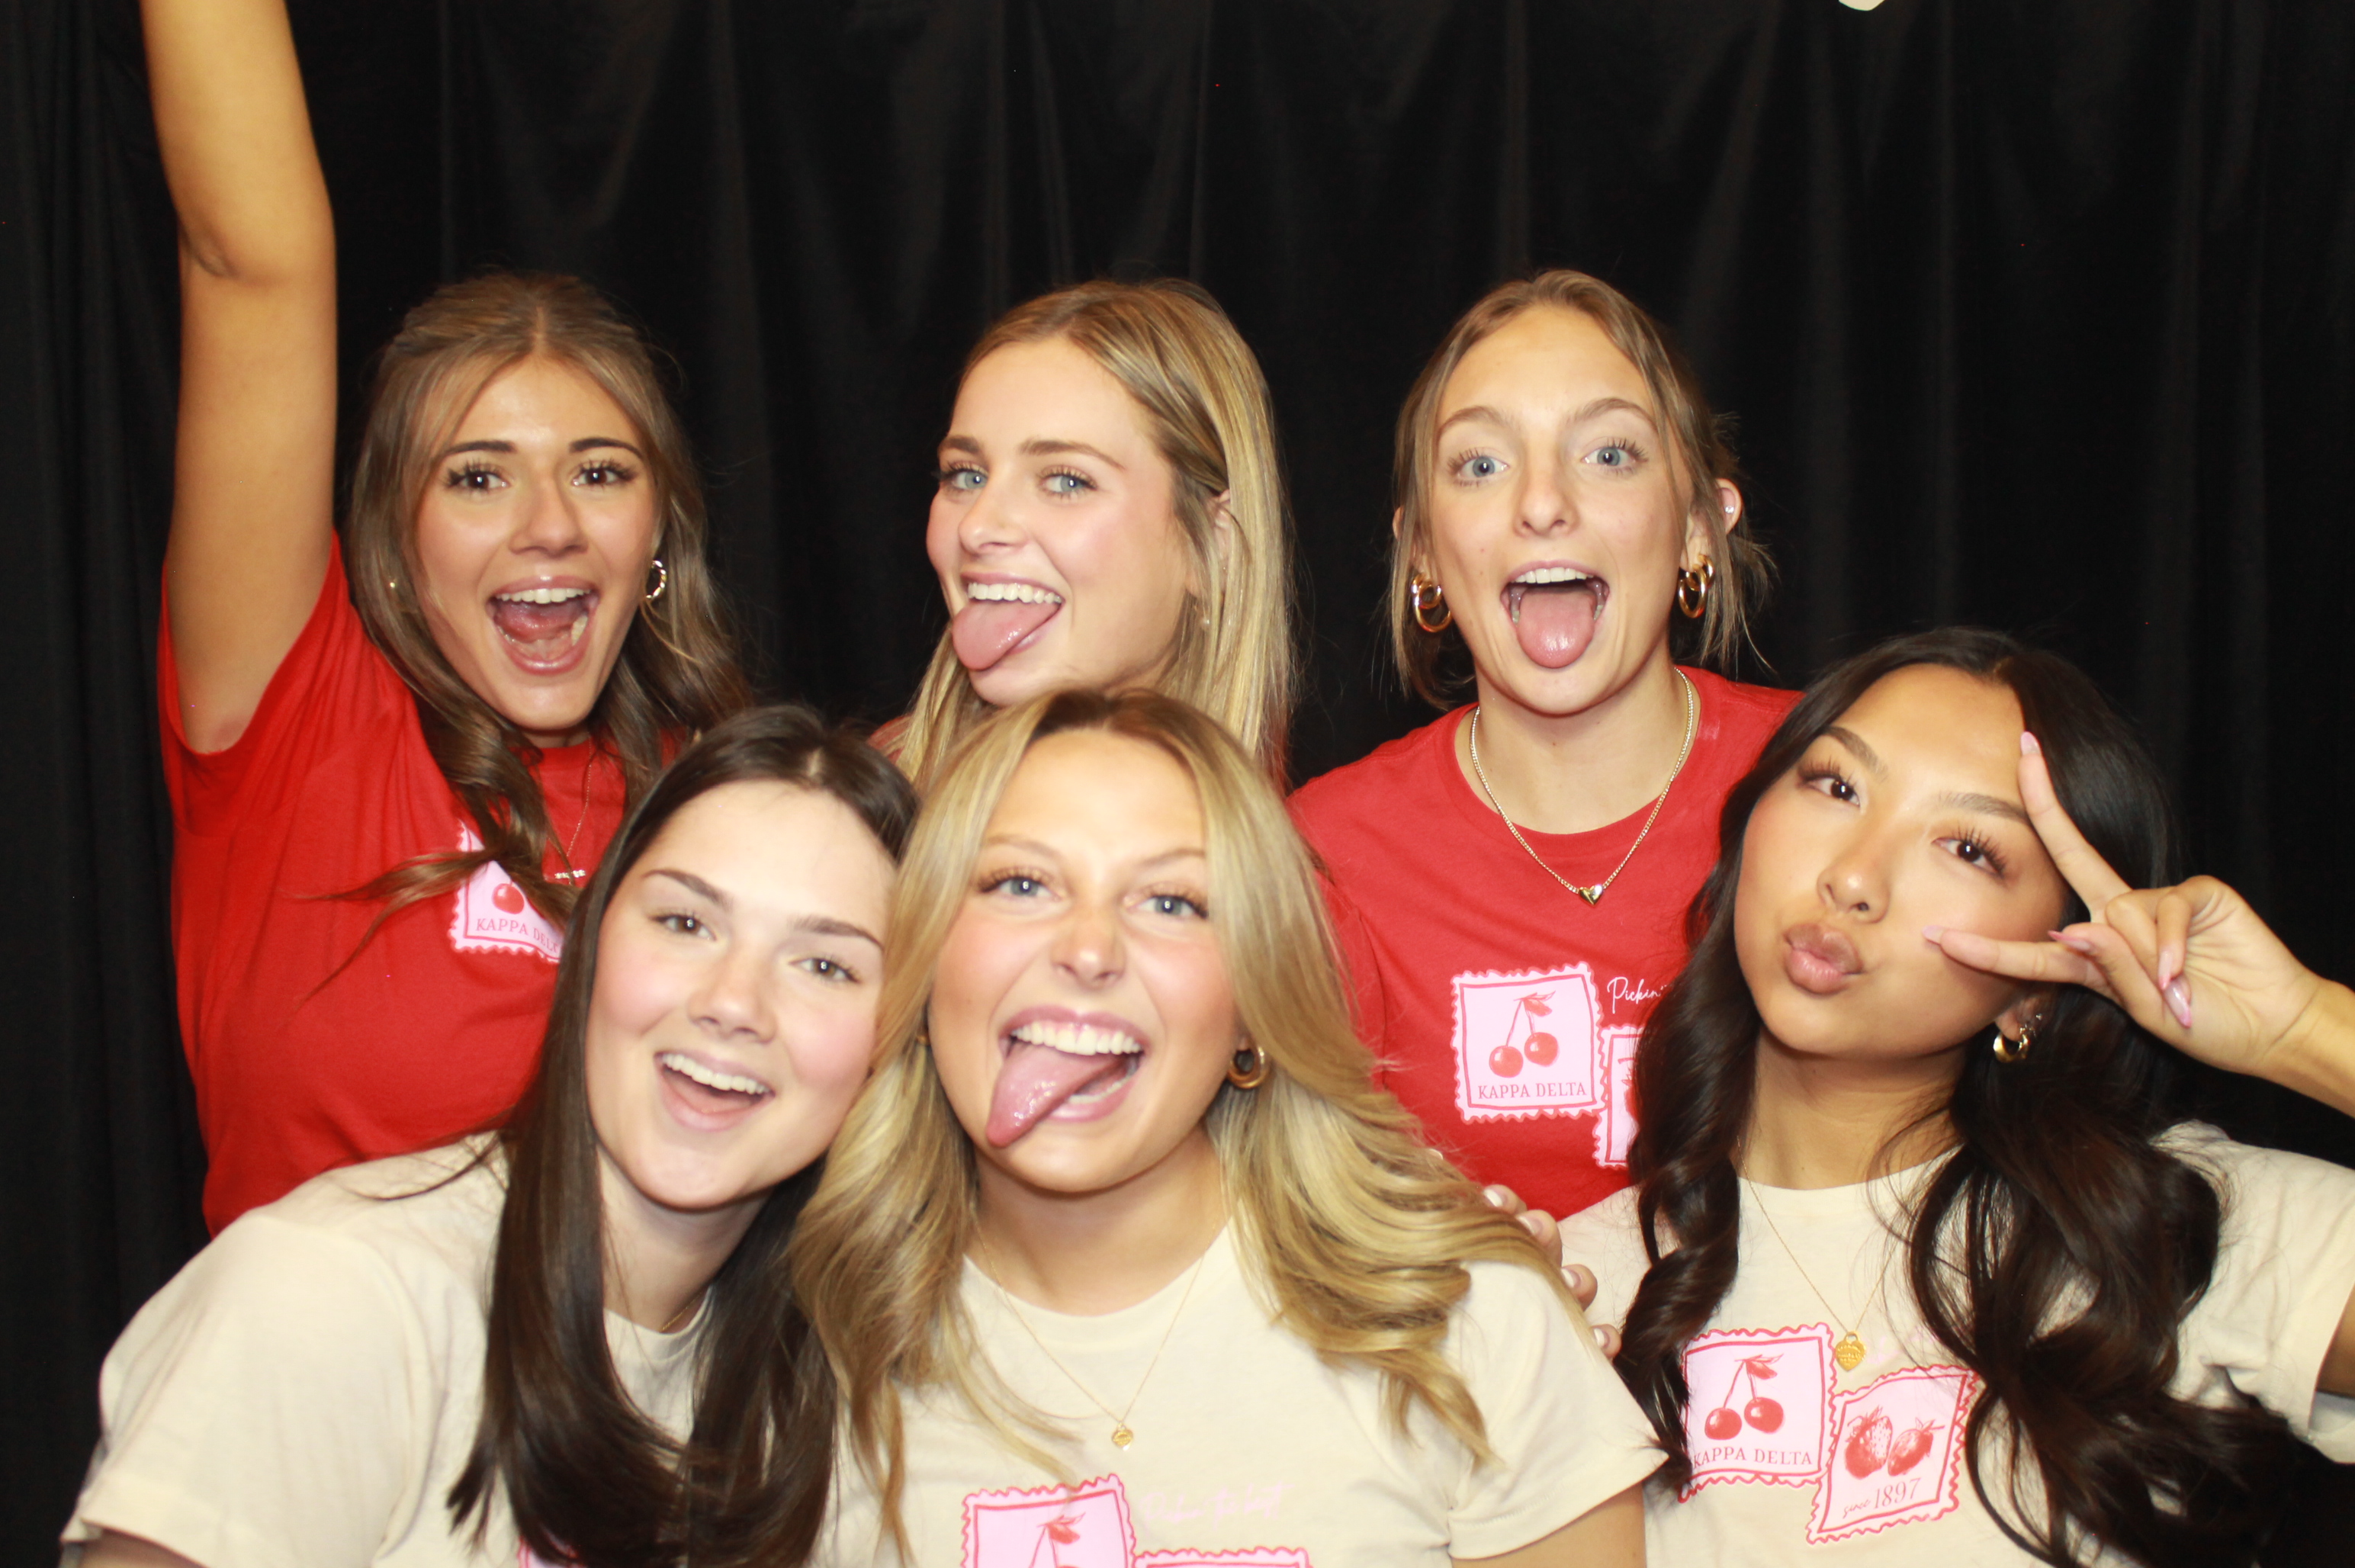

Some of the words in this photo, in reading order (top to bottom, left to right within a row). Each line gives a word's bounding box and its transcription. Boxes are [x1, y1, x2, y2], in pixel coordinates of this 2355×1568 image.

[475, 917, 529, 936] KAPPA
[533, 927, 559, 953] DELT
[1478, 1084, 1530, 1100] KAPPA
[1536, 1081, 1588, 1097] DELTA
[1694, 1446, 1747, 1469] KAPPA
[1754, 1448, 1813, 1466] DELTA
[1843, 1498, 1871, 1519] since
[1873, 1476, 1922, 1510] 1897
